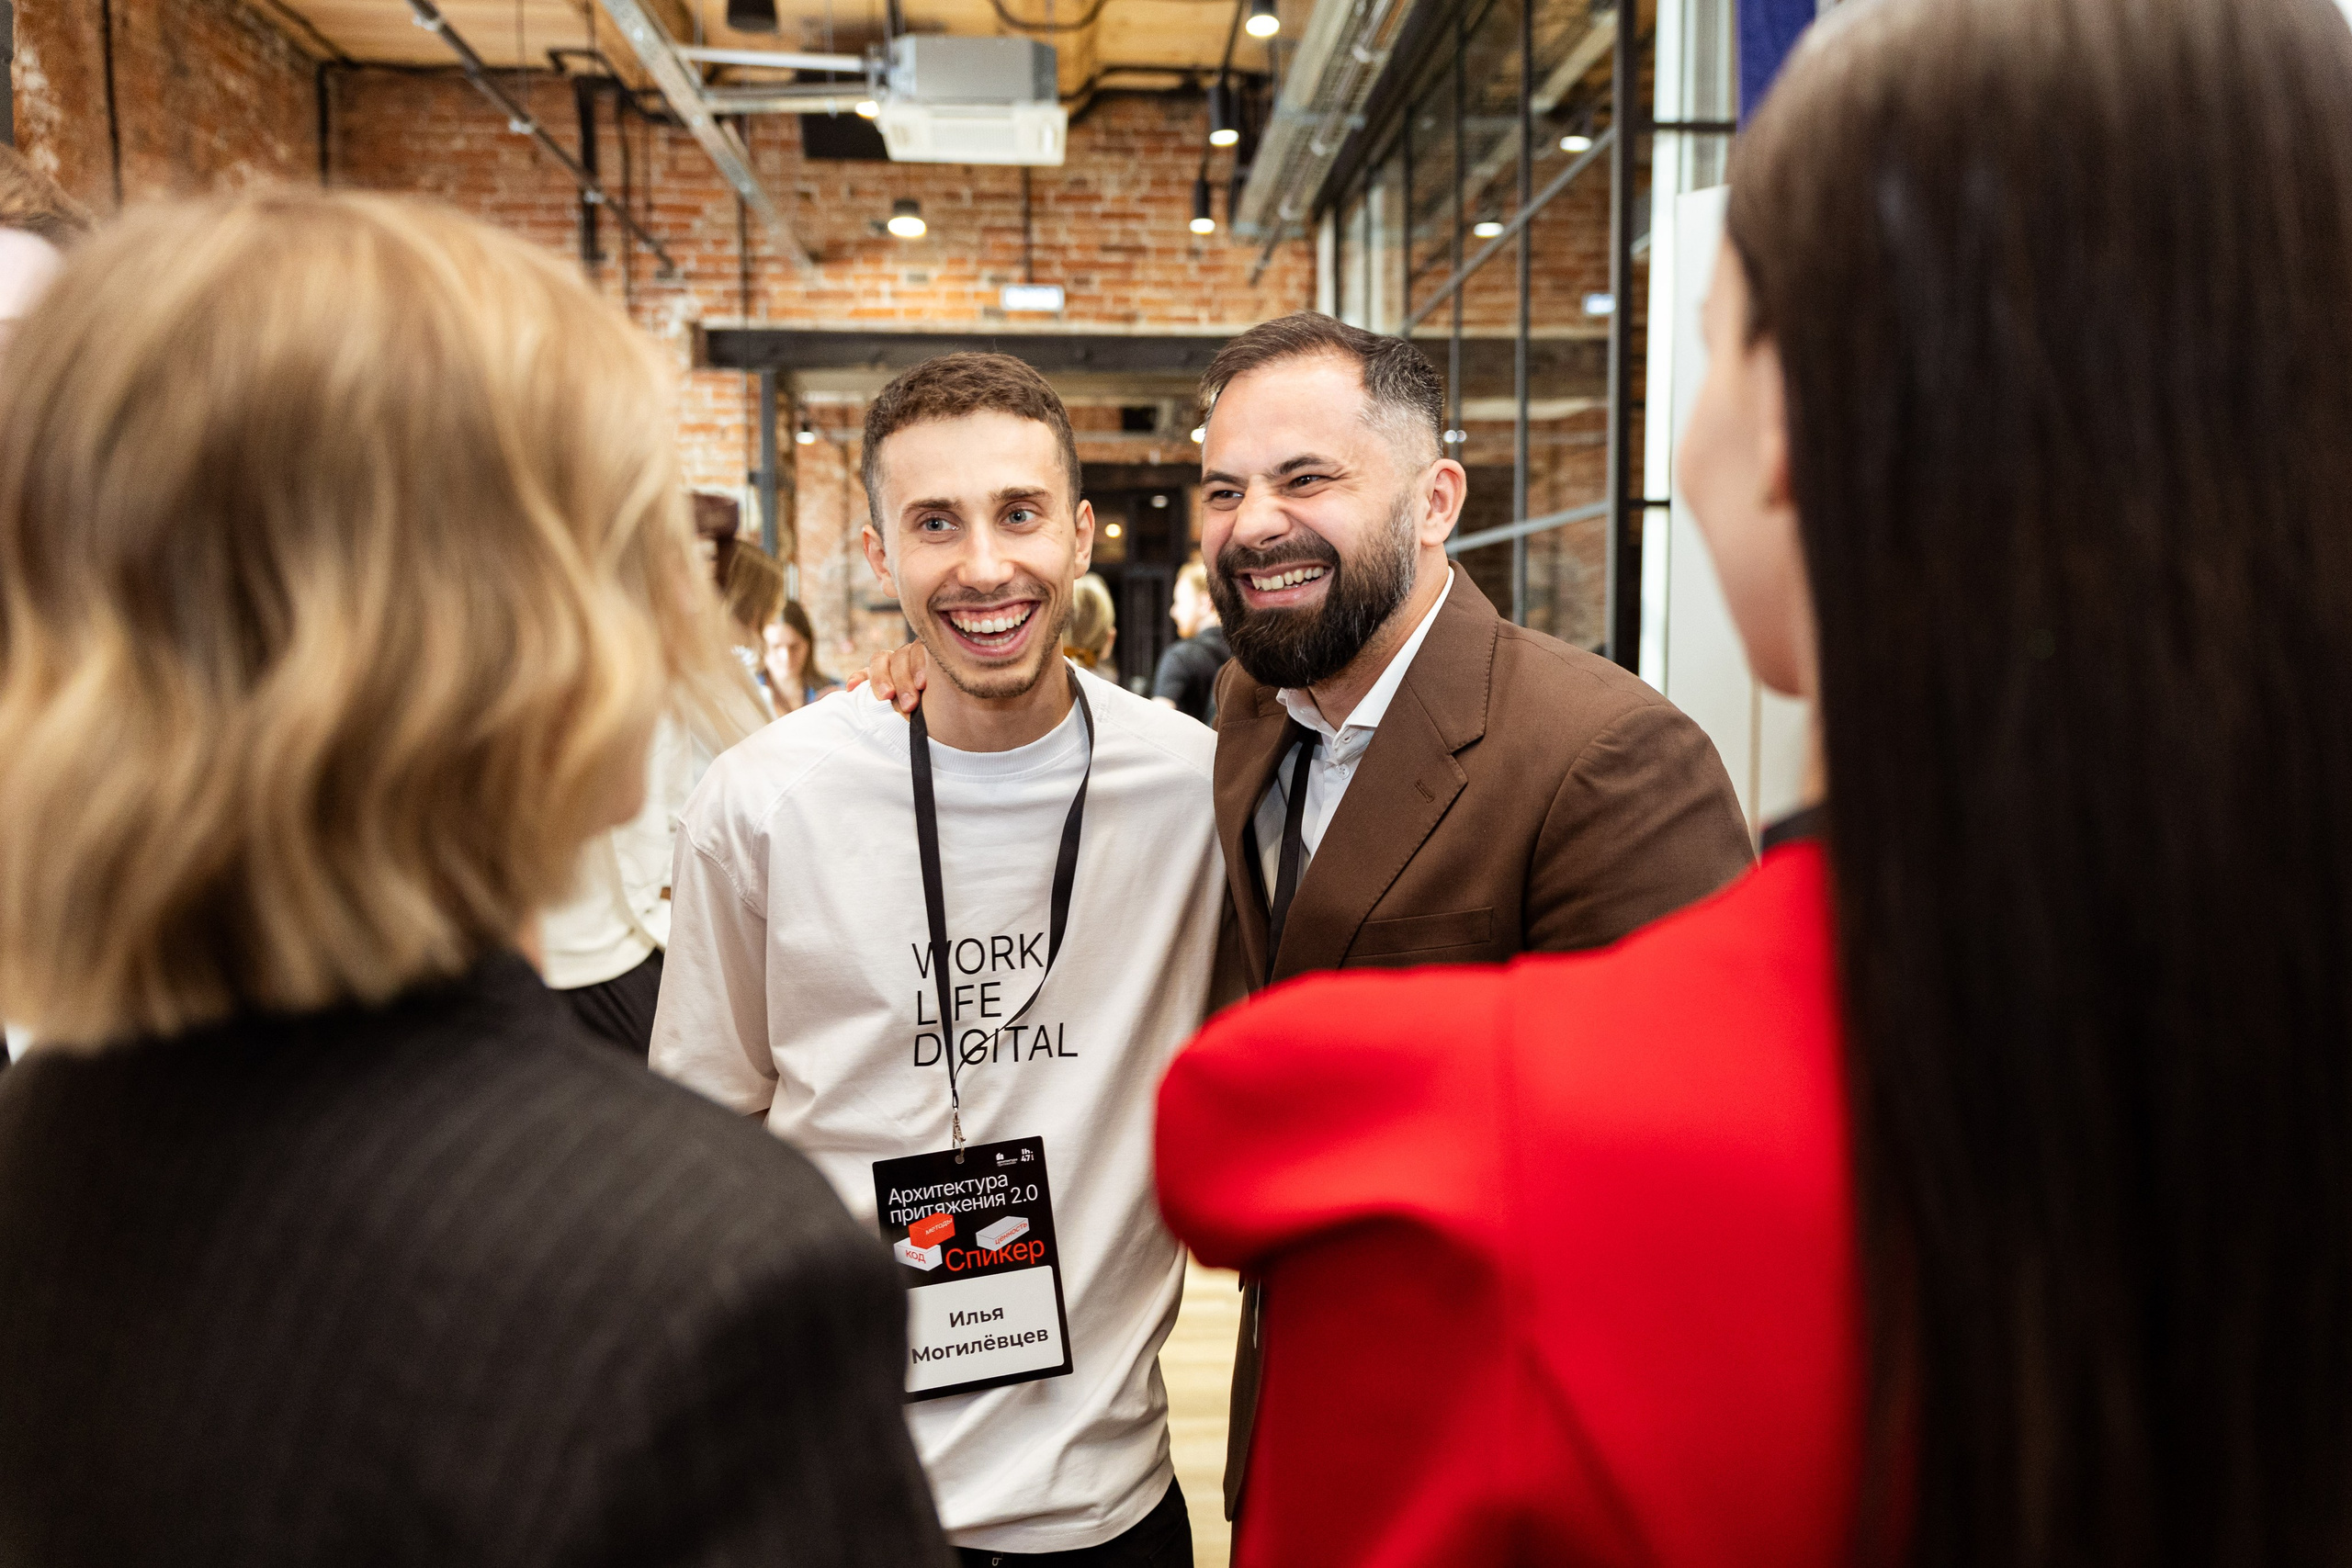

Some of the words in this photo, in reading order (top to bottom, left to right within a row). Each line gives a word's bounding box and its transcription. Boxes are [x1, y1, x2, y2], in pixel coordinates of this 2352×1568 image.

[911, 931, 1045, 979] WORK
[917, 981, 1001, 1026] LFE
[913, 1021, 1079, 1067] DGITAL
[888, 1174, 1009, 1208] Архитектура
[889, 1192, 1006, 1226] притяжения
[1010, 1184, 1039, 1204] 2.0
[944, 1239, 1046, 1272] Спикер
[948, 1306, 1004, 1328] Илья
[910, 1328, 1049, 1364] Могилёвцев
